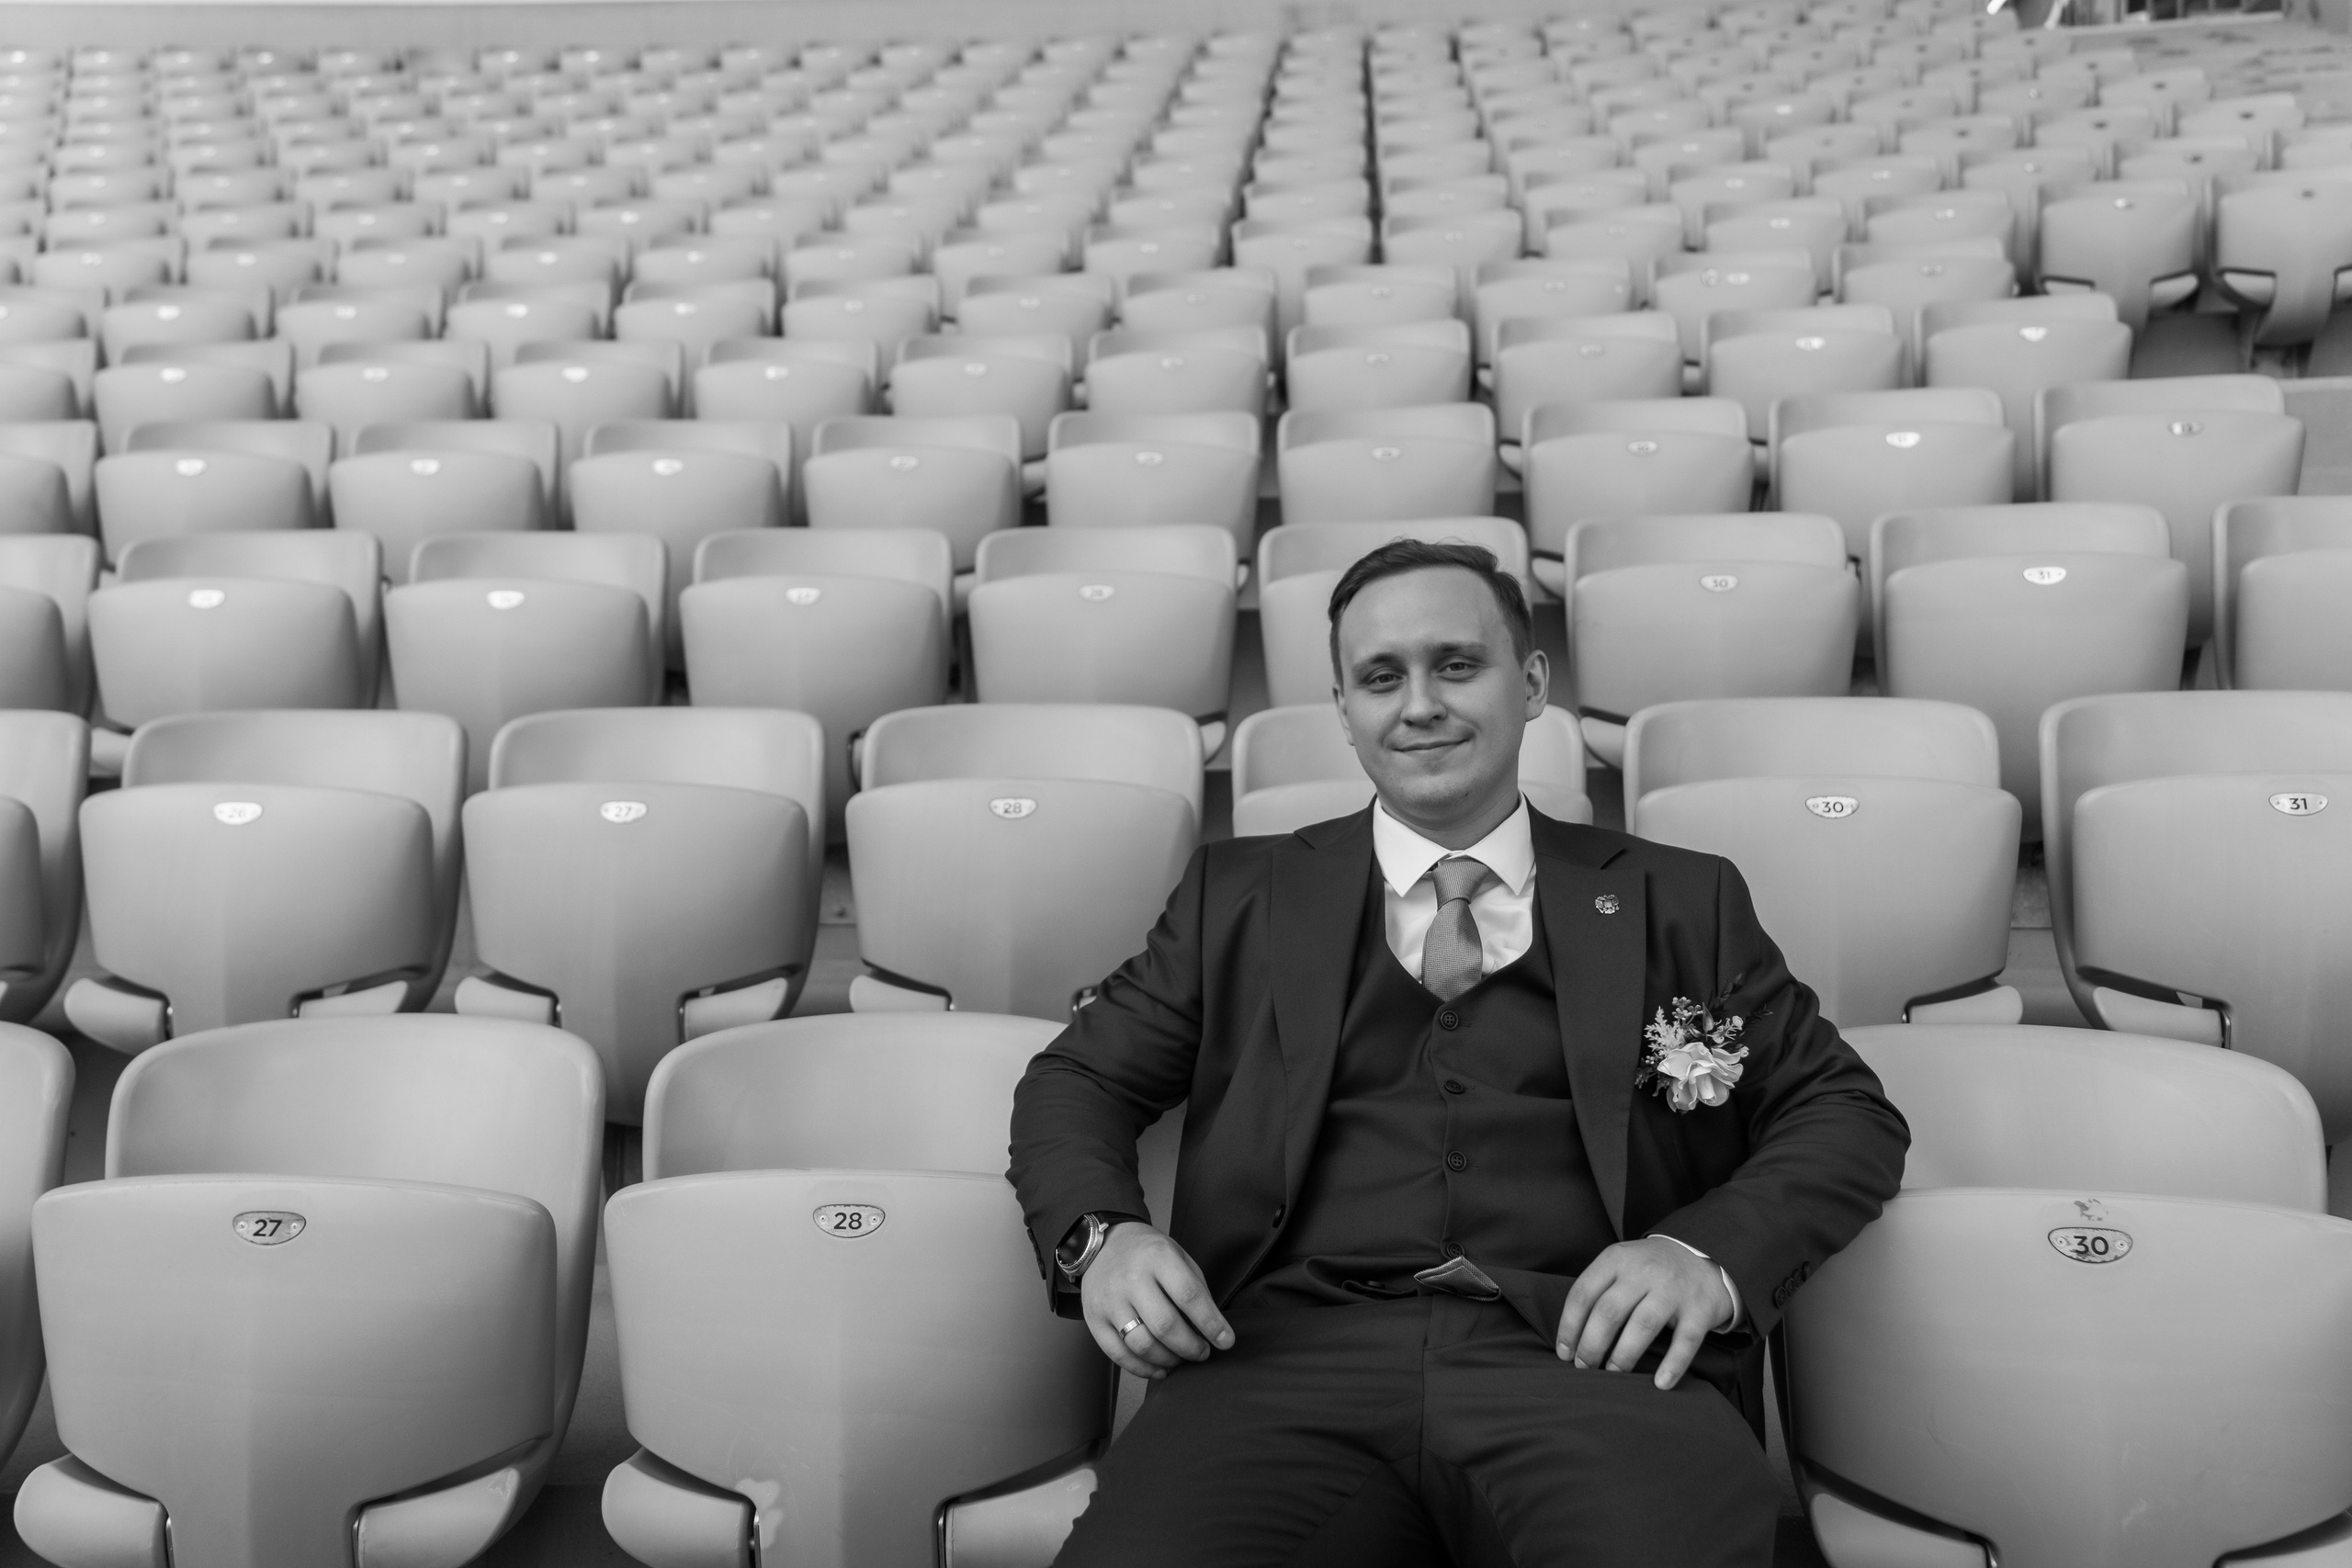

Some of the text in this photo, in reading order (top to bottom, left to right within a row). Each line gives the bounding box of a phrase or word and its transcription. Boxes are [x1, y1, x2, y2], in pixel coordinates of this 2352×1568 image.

[1003, 803, 1022, 814] 28
[1823, 801, 1844, 813] 30
[2289, 798, 2308, 810] 31
[614, 807, 632, 818] 27
[833, 1212, 863, 1230] 28
[253, 1219, 282, 1236] 27
[2074, 1235, 2109, 1256] 30
